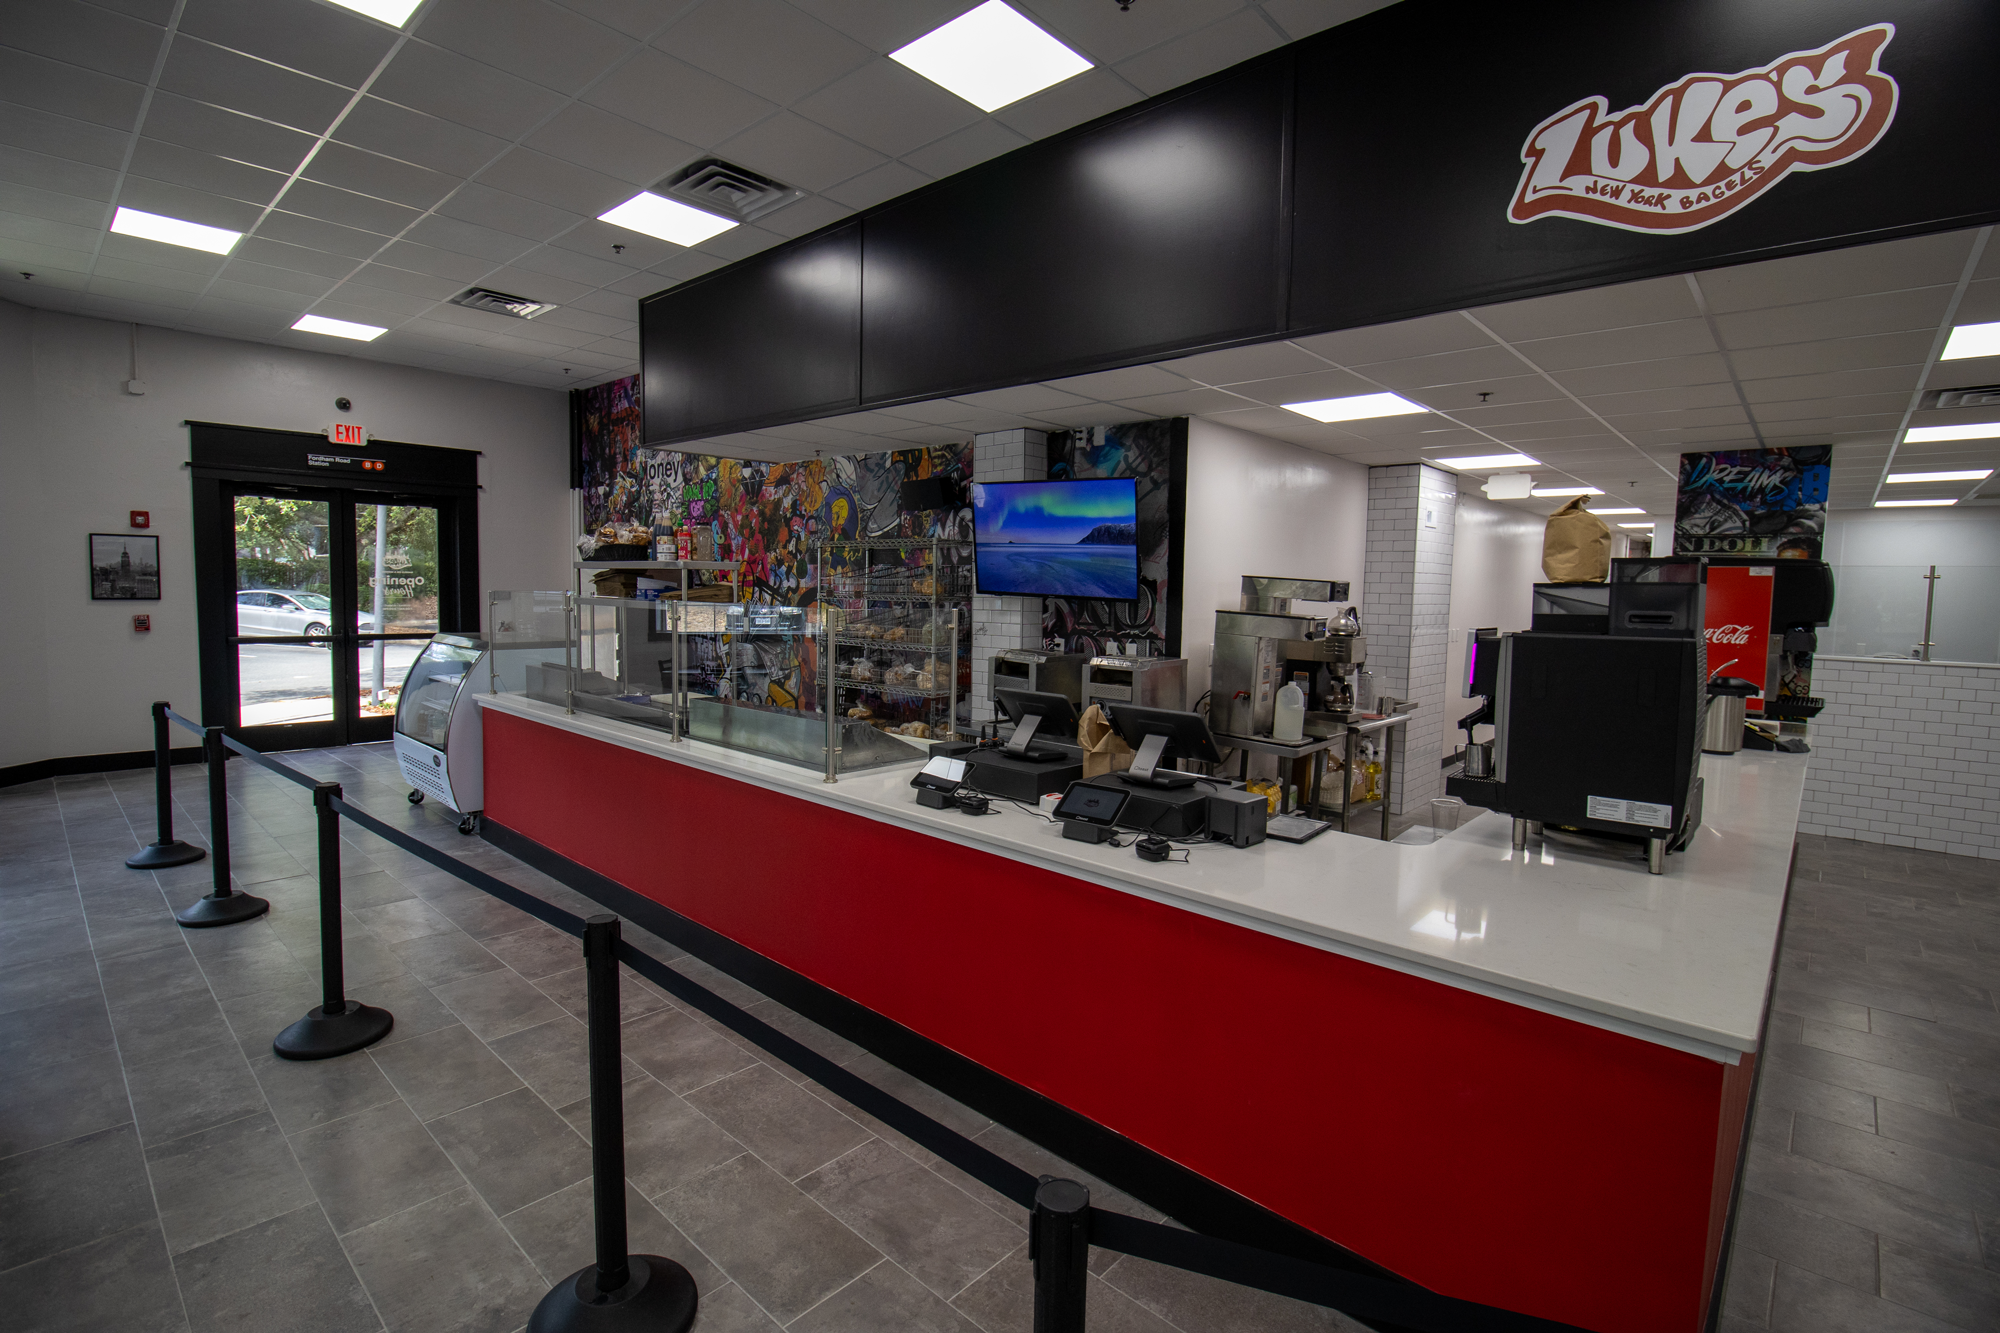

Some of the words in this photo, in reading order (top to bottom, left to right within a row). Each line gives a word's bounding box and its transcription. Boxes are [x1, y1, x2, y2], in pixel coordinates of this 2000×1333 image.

[1585, 180, 1626, 200] NEW
[1679, 160, 1767, 211] BAGELS
[335, 423, 363, 444] EXIT
